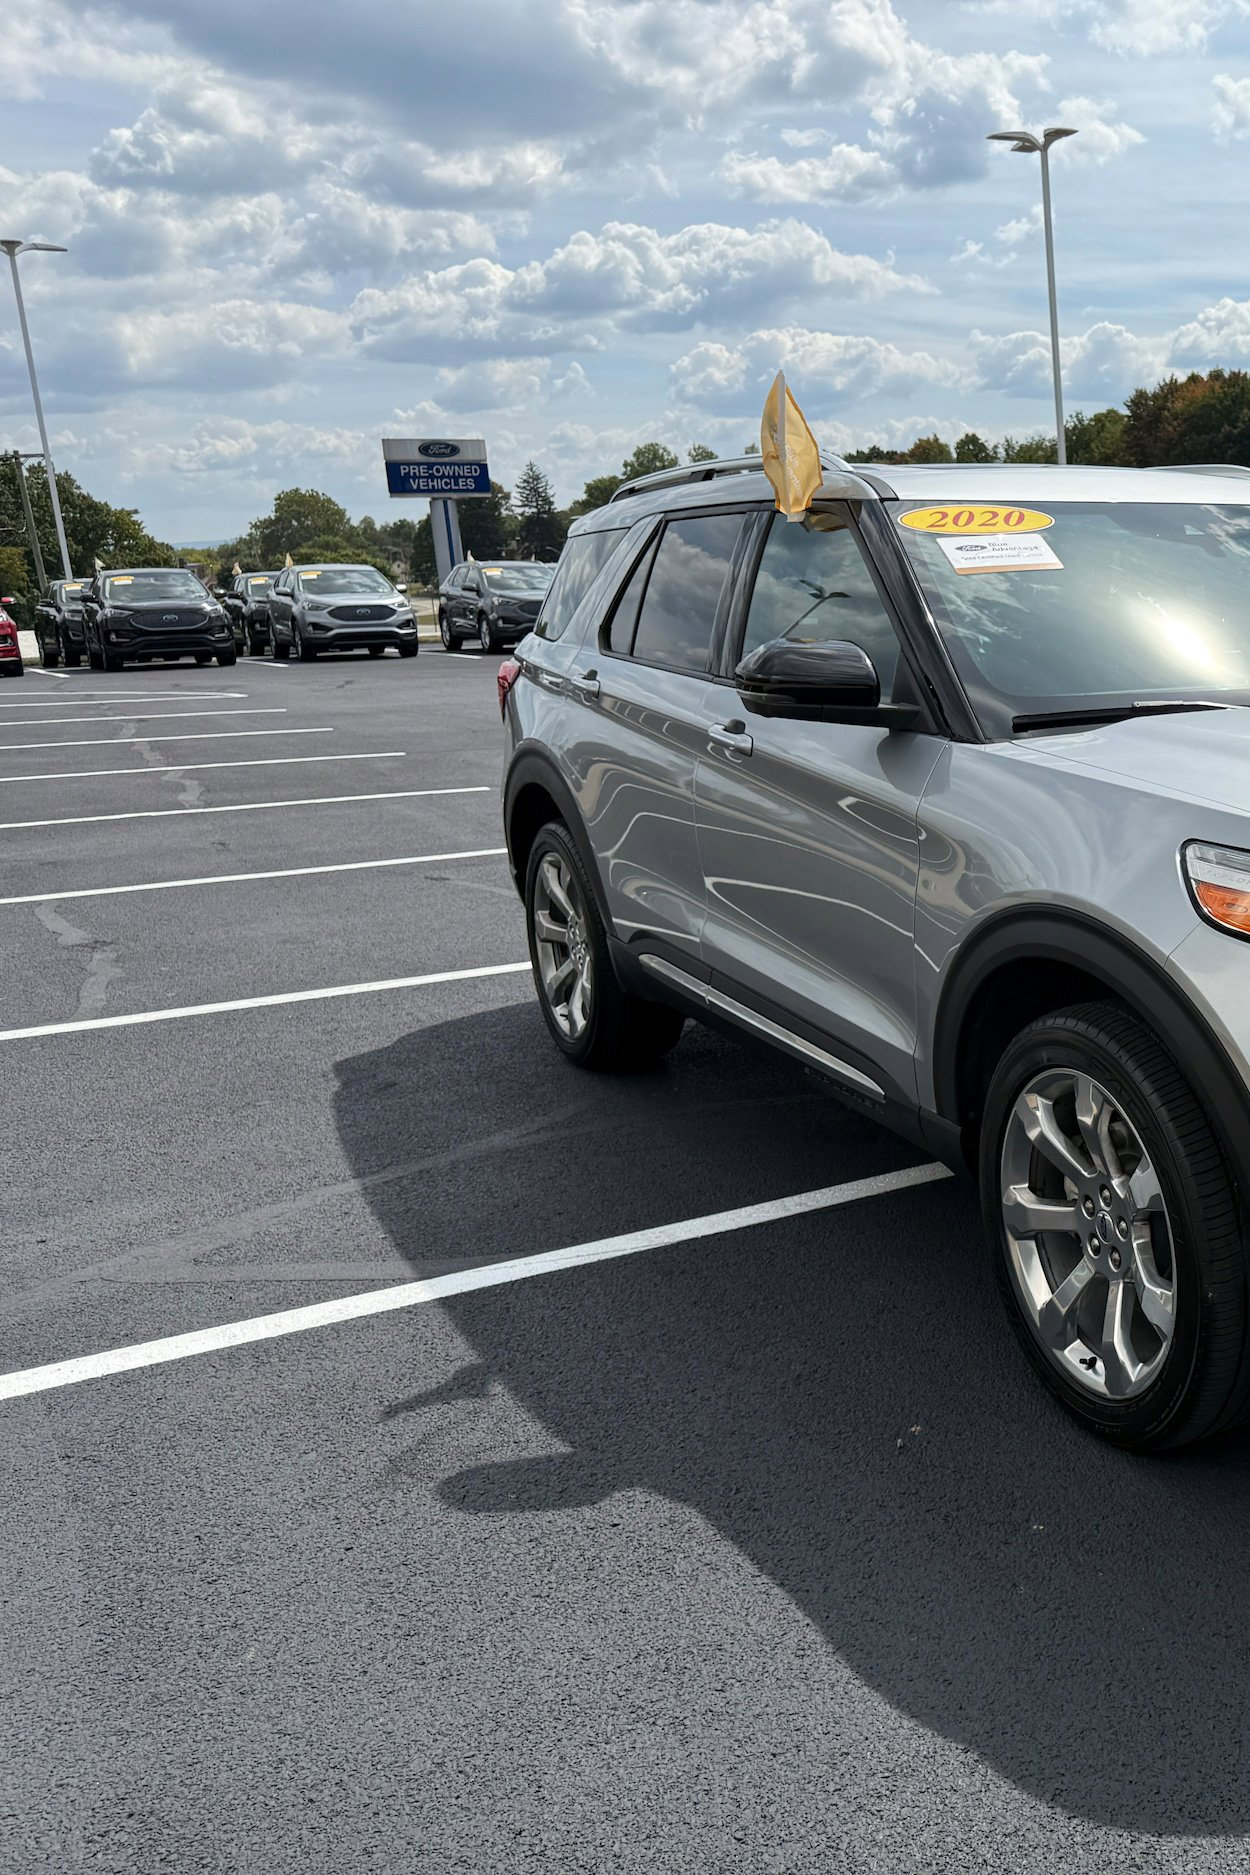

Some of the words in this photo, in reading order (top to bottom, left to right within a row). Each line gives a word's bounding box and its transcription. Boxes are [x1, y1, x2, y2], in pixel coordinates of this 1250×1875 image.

[428, 444, 452, 455] Ford
[400, 465, 480, 476] PRE-OWNED
[409, 478, 476, 490] VEHICLES
[926, 510, 1026, 529] 2020
